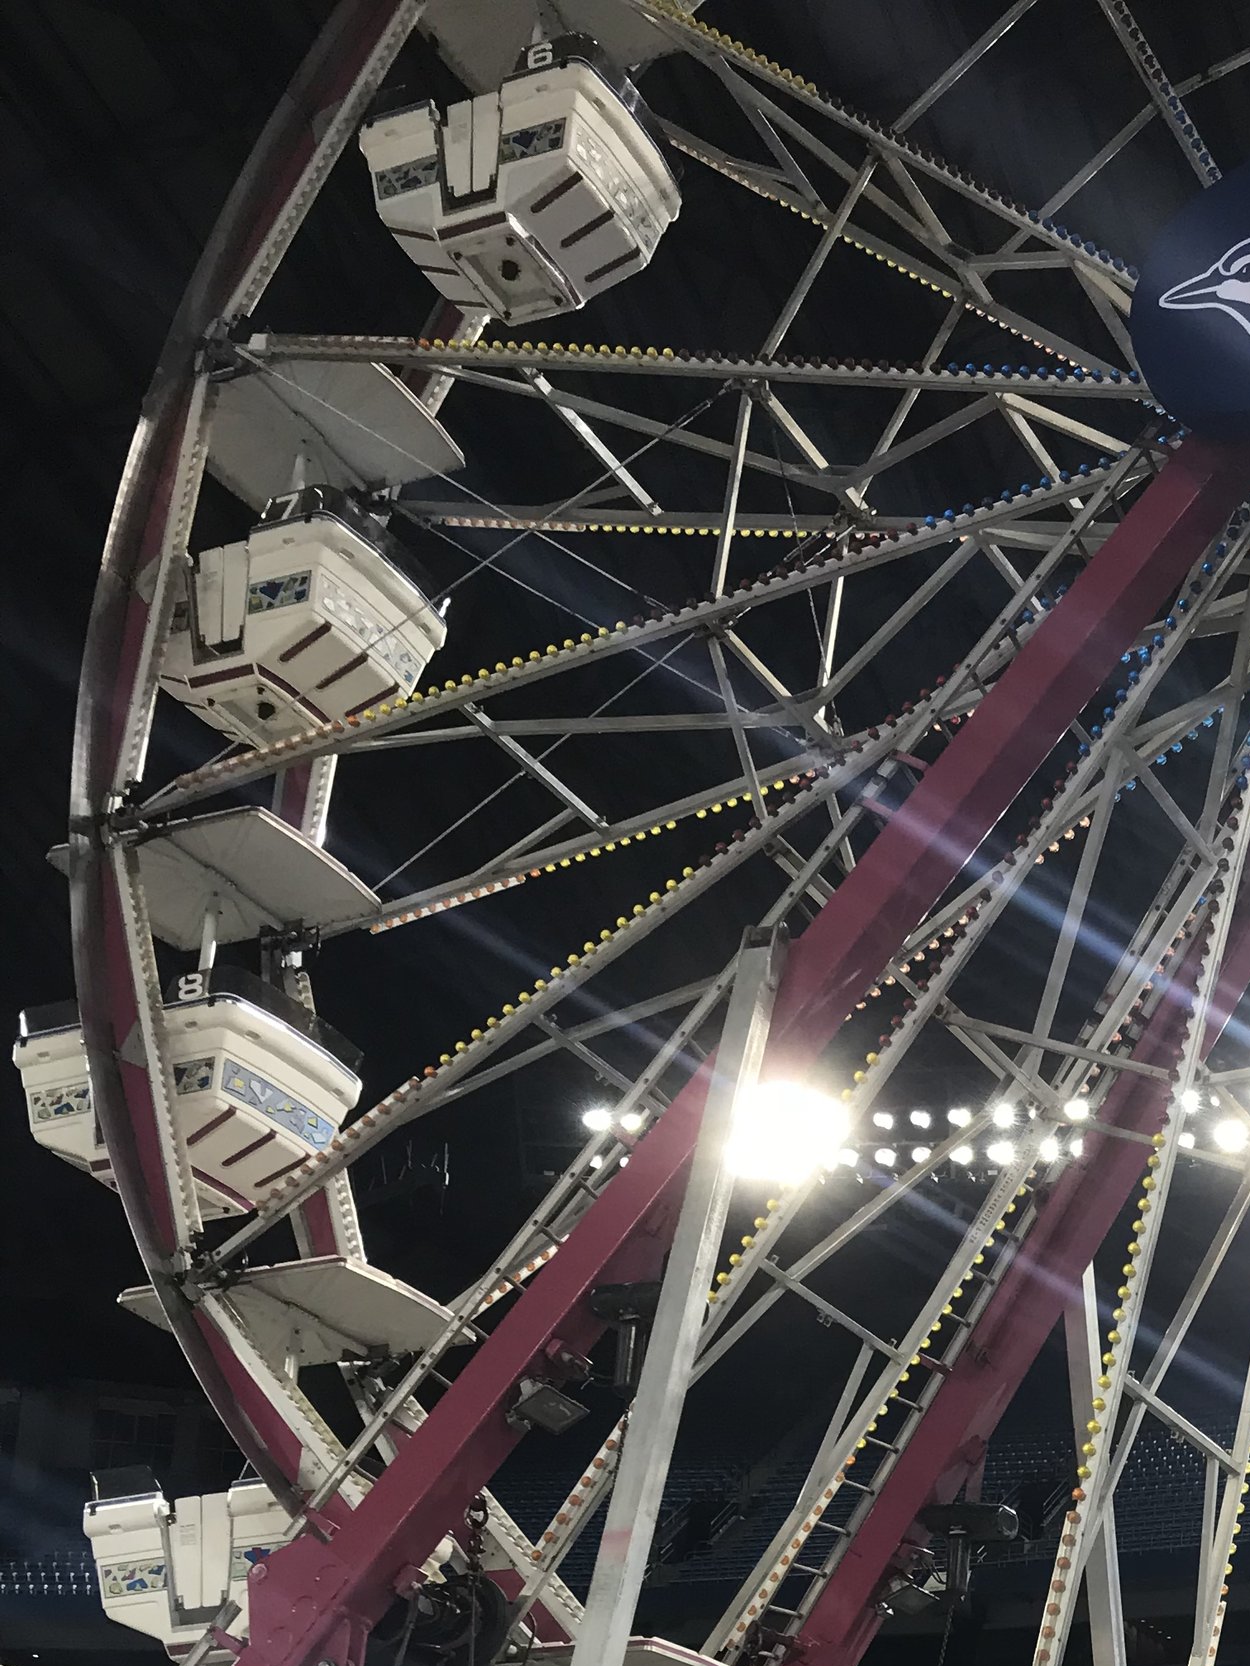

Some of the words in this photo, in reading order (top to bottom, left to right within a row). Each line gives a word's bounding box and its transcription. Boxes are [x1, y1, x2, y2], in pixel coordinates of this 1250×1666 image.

[528, 42, 552, 69] 6
[276, 492, 299, 520] 7
[178, 973, 203, 1001] 8
